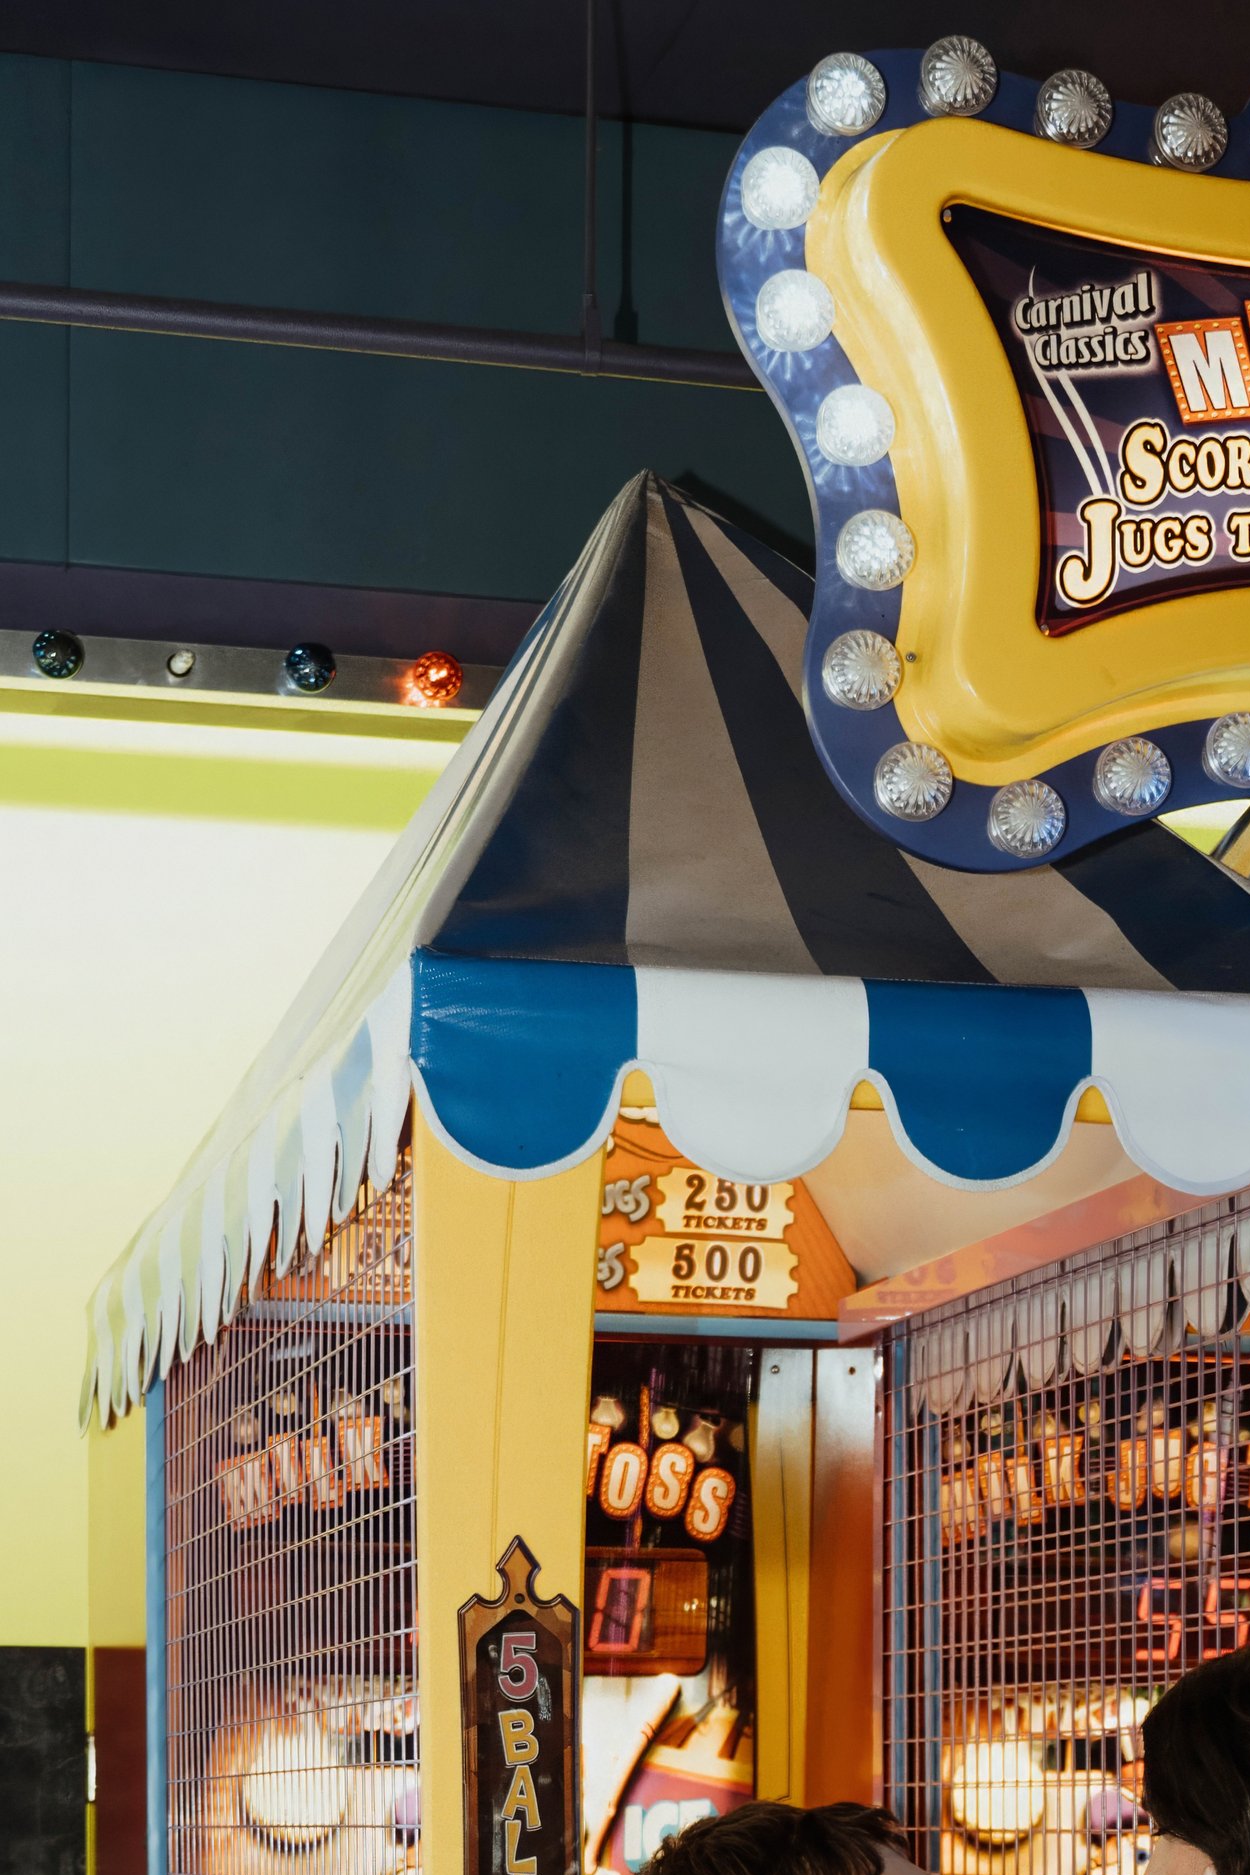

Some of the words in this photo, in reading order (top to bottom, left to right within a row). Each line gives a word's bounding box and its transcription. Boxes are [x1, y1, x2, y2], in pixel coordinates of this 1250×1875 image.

[1014, 271, 1154, 332] Carnival
[1034, 327, 1149, 368] Classics
[685, 1174, 768, 1213] 250
[683, 1215, 768, 1231] TICKETS
[672, 1243, 763, 1283] 500
[671, 1285, 757, 1301] TICKETS
[498, 1632, 537, 1701] 5
